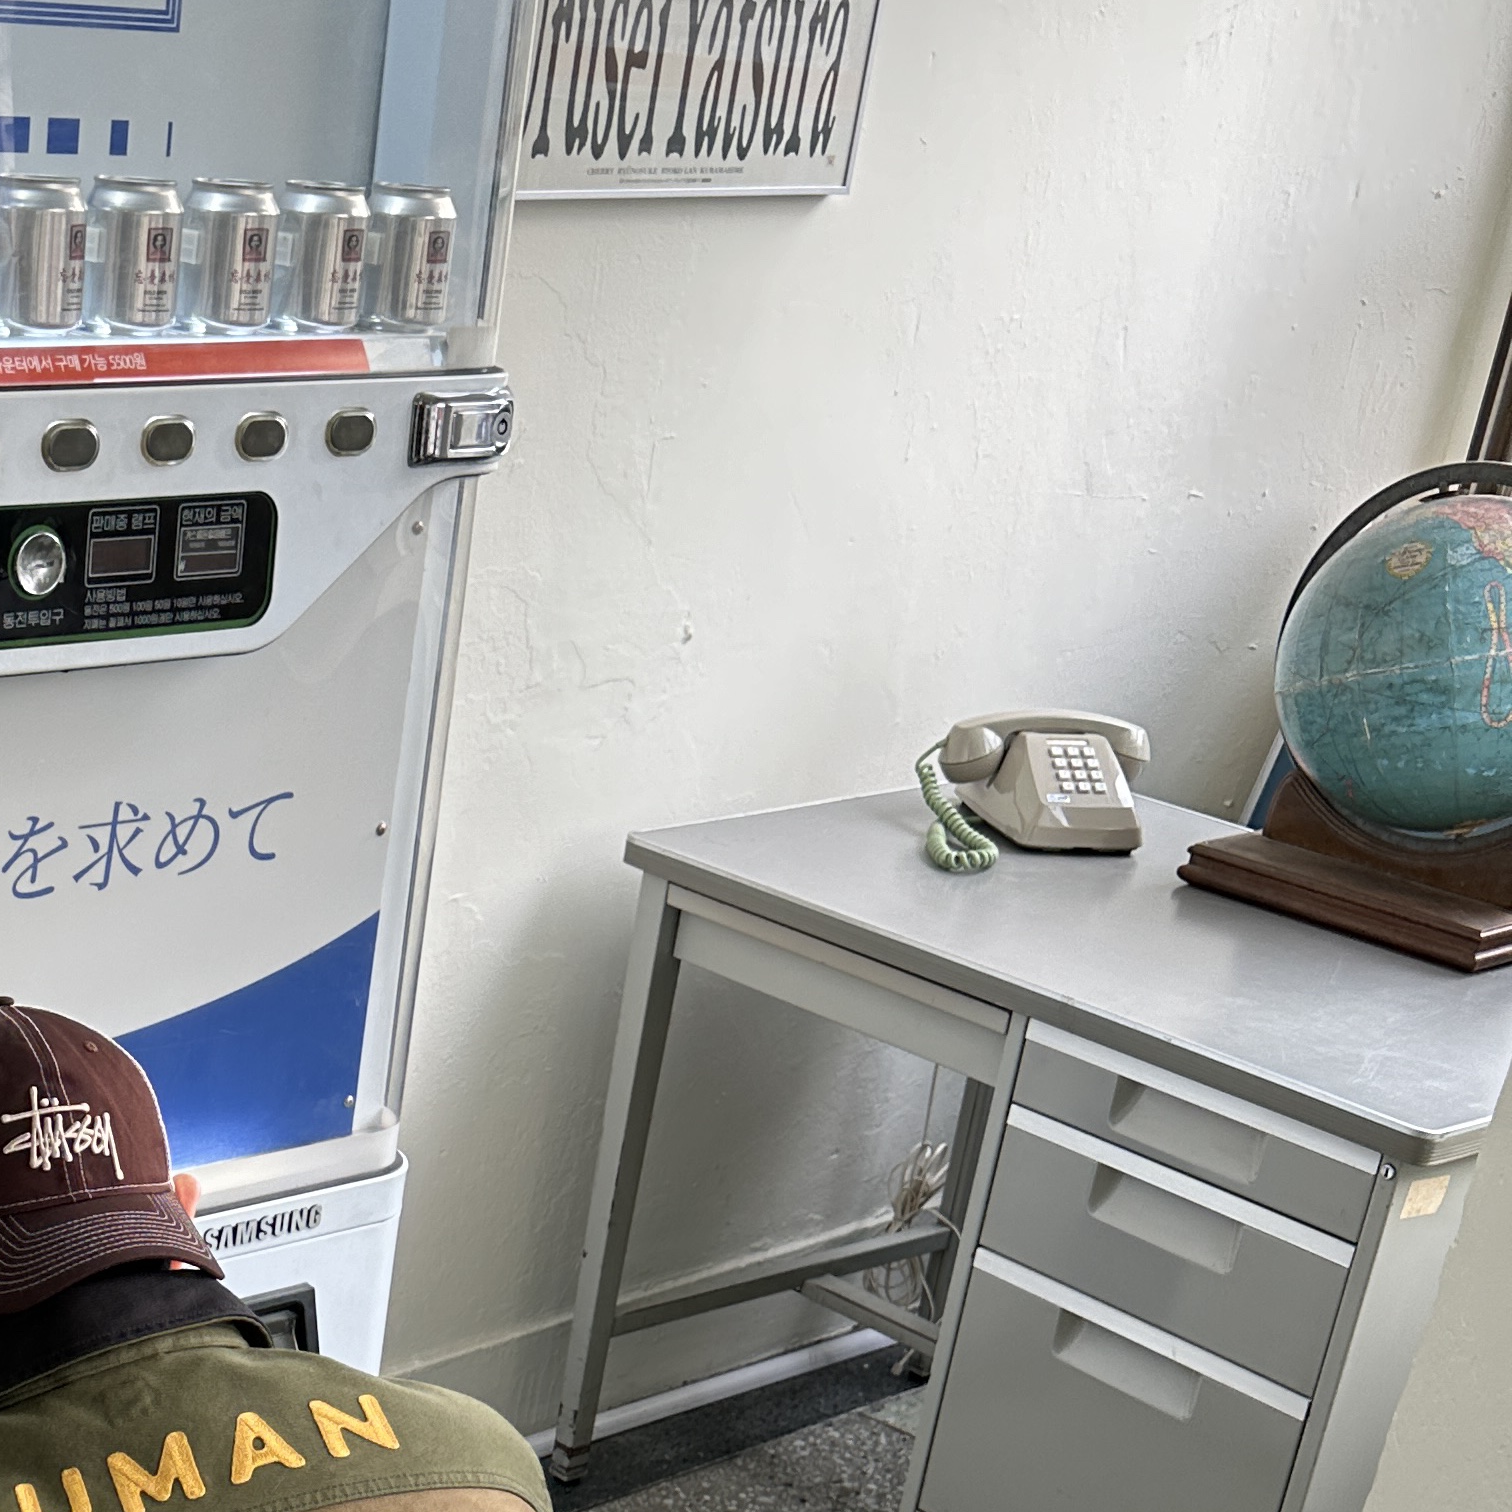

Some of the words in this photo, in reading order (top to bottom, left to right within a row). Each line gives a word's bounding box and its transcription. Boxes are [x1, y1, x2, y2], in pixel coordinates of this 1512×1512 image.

[522, 0, 675, 161] rusei
[55, 354, 82, 373] 구매
[82, 353, 107, 371] 가능
[109, 352, 147, 370] 5500원
[91, 513, 128, 532] 판매중
[131, 511, 155, 530] 램프
[182, 507, 216, 525] 현재의
[220, 505, 243, 522] 금액
[85, 588, 126, 603] 사용방법
[3, 608, 65, 630] 동전투입구
[203, 1203, 323, 1251] SAMSUNG
